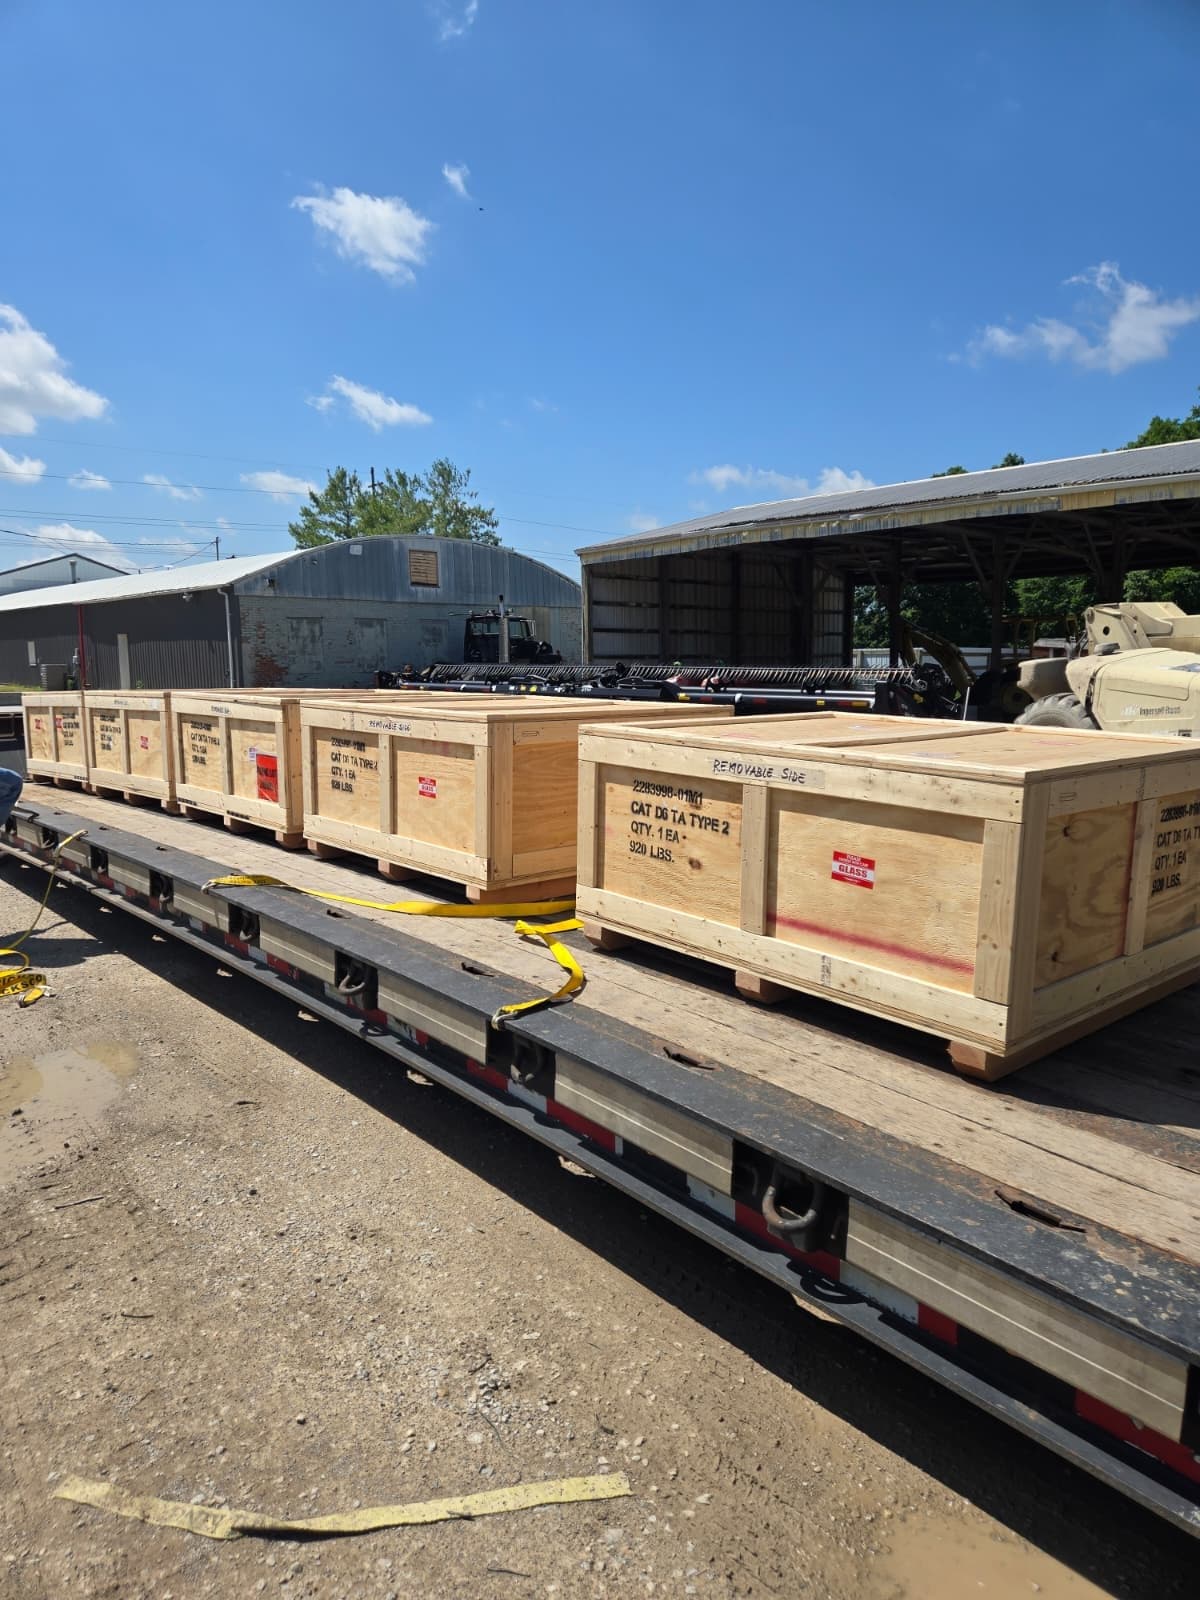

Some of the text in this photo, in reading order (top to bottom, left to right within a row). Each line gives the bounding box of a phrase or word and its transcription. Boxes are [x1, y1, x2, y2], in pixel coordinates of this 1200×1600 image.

[331, 751, 341, 761] CAT
[713, 759, 807, 784] REMOVABLE SIDE
[631, 801, 730, 835] CAT D6 TA TYPE 2
[630, 820, 654, 837] QTY.
[629, 840, 675, 863] 920 LBS.
[838, 864, 868, 878] GLASS
